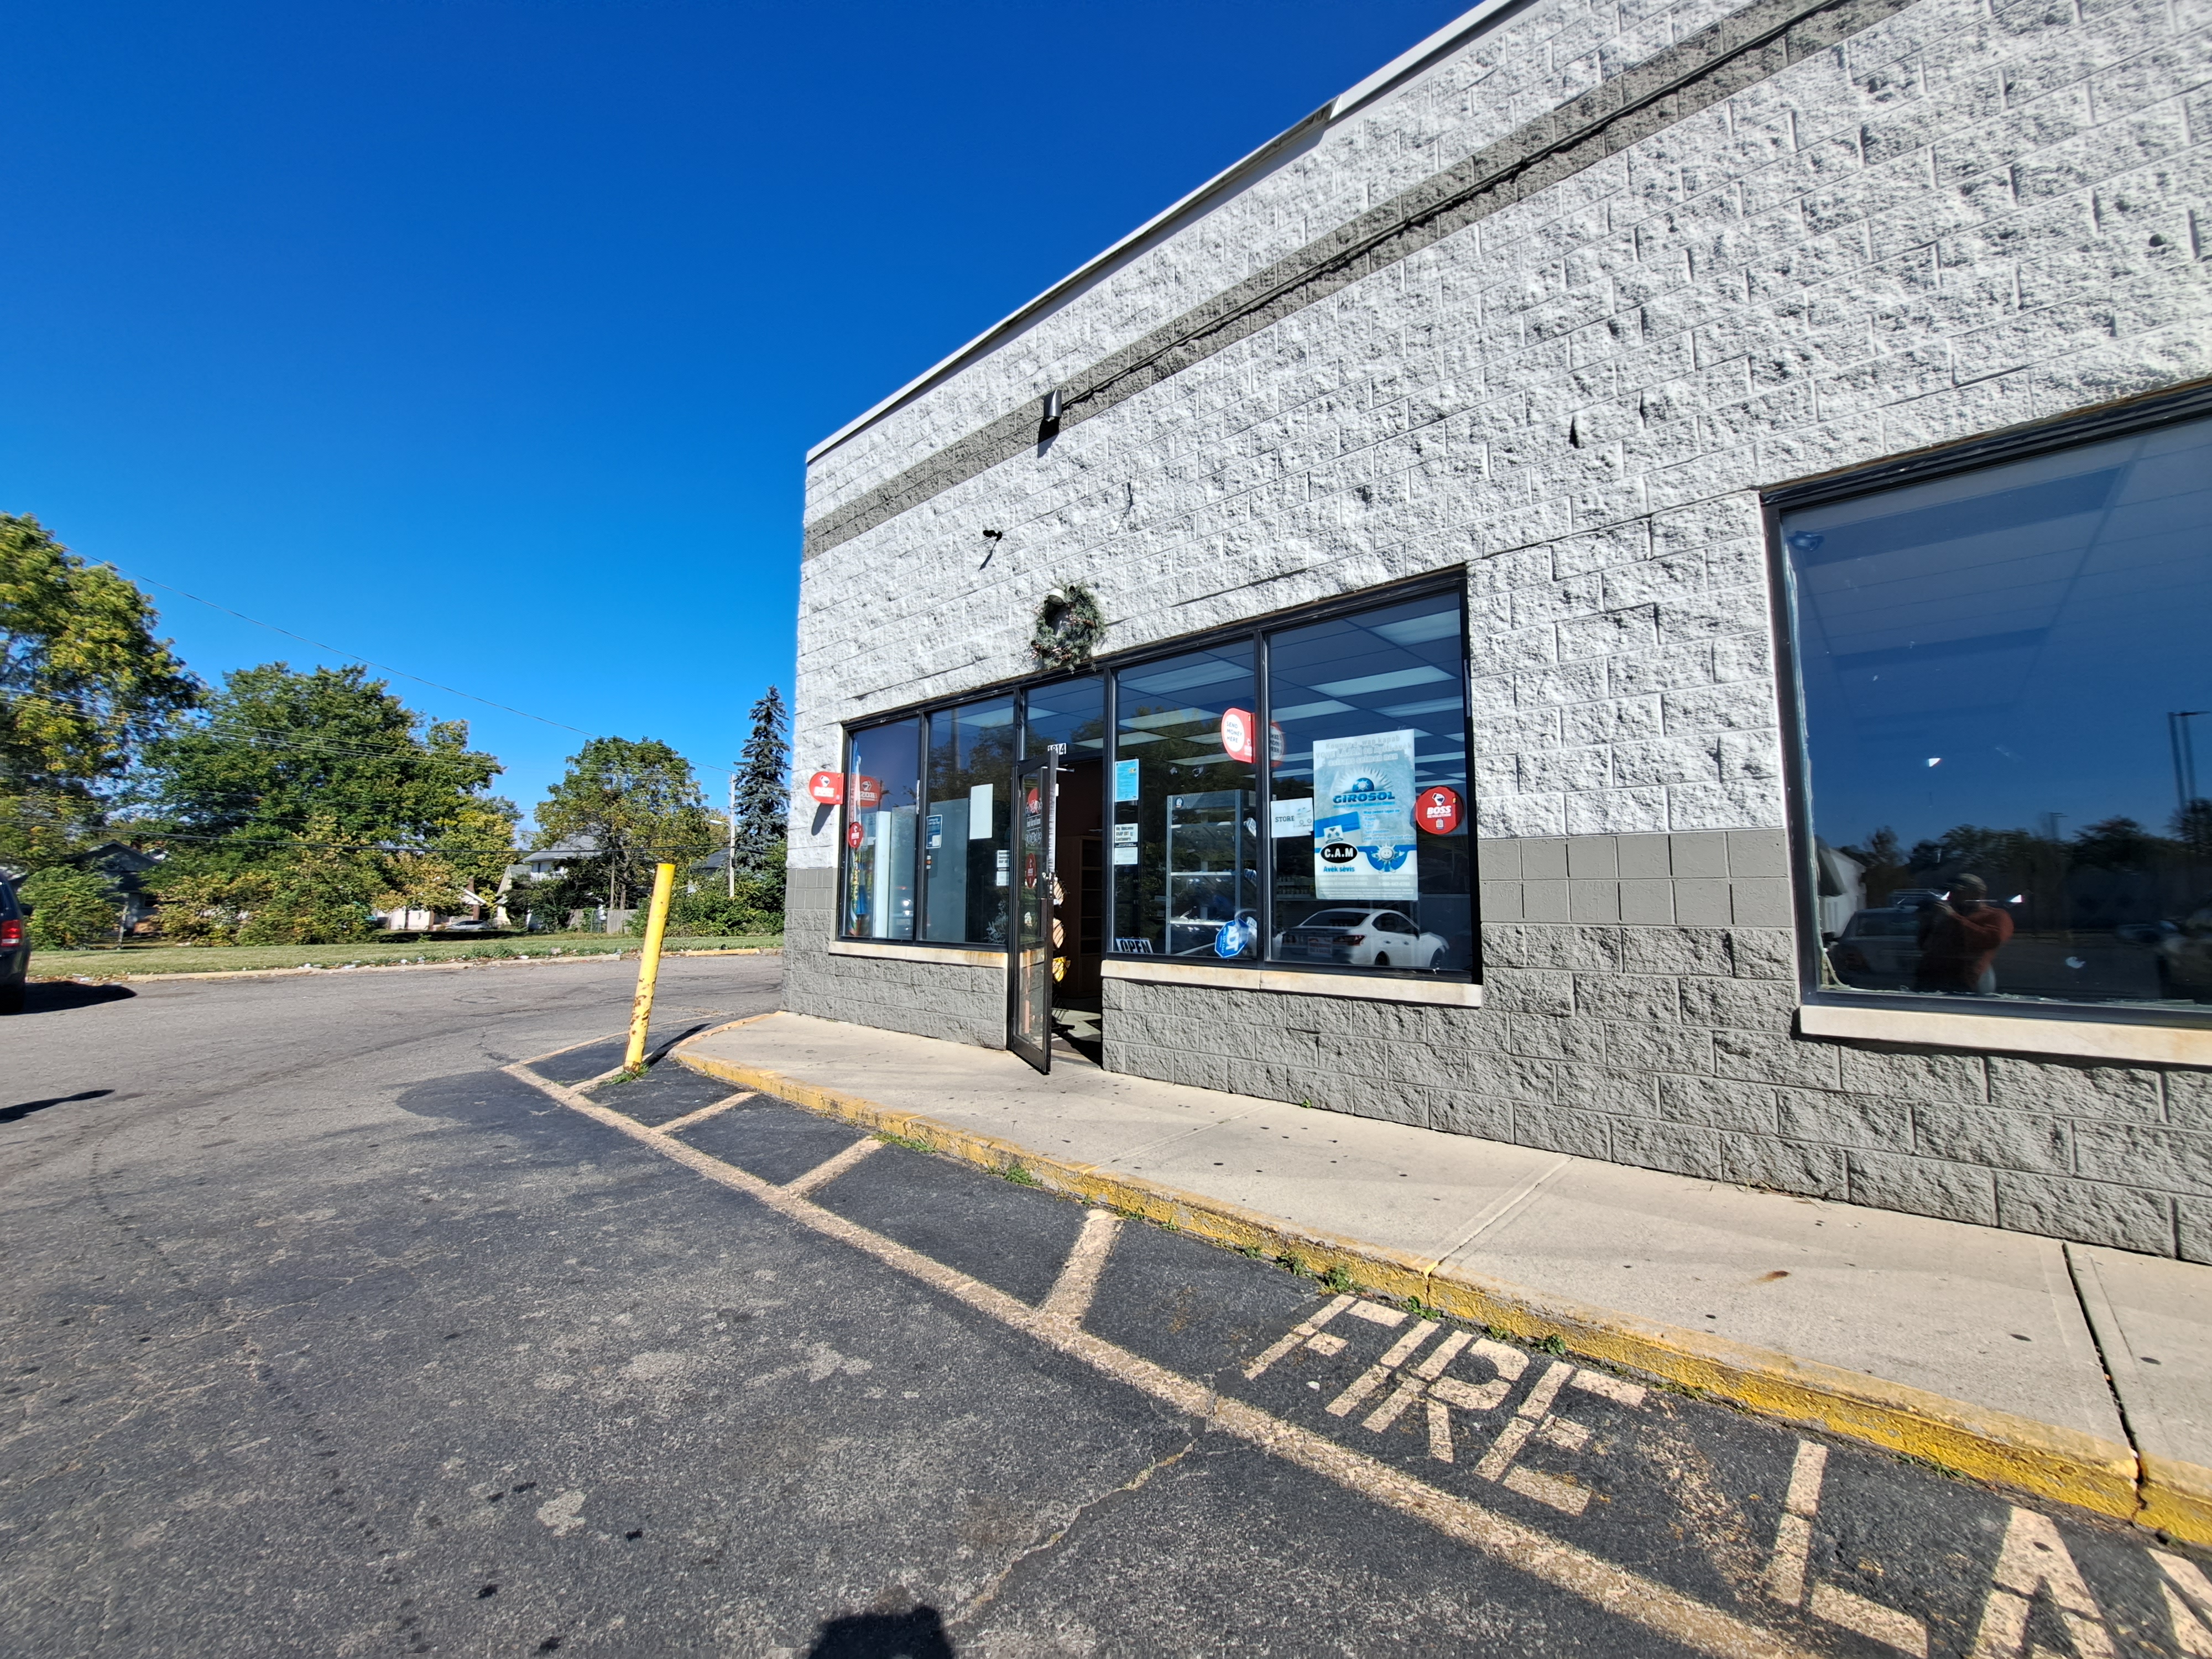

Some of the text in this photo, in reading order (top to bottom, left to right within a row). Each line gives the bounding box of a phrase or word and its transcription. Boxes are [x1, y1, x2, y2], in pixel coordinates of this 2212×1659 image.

[1227, 728, 1242, 737] MONEY
[1378, 735, 1400, 744] kapab
[1337, 747, 1361, 757] LAJAN
[1333, 791, 1395, 804] GIROSOL
[1427, 806, 1452, 815] BOSS
[1324, 848, 1354, 858] C.A.M
[1226, 926, 1239, 951] ADT
[1120, 940, 1151, 953] OPEN
[1243, 1294, 1647, 1517] FIRE
